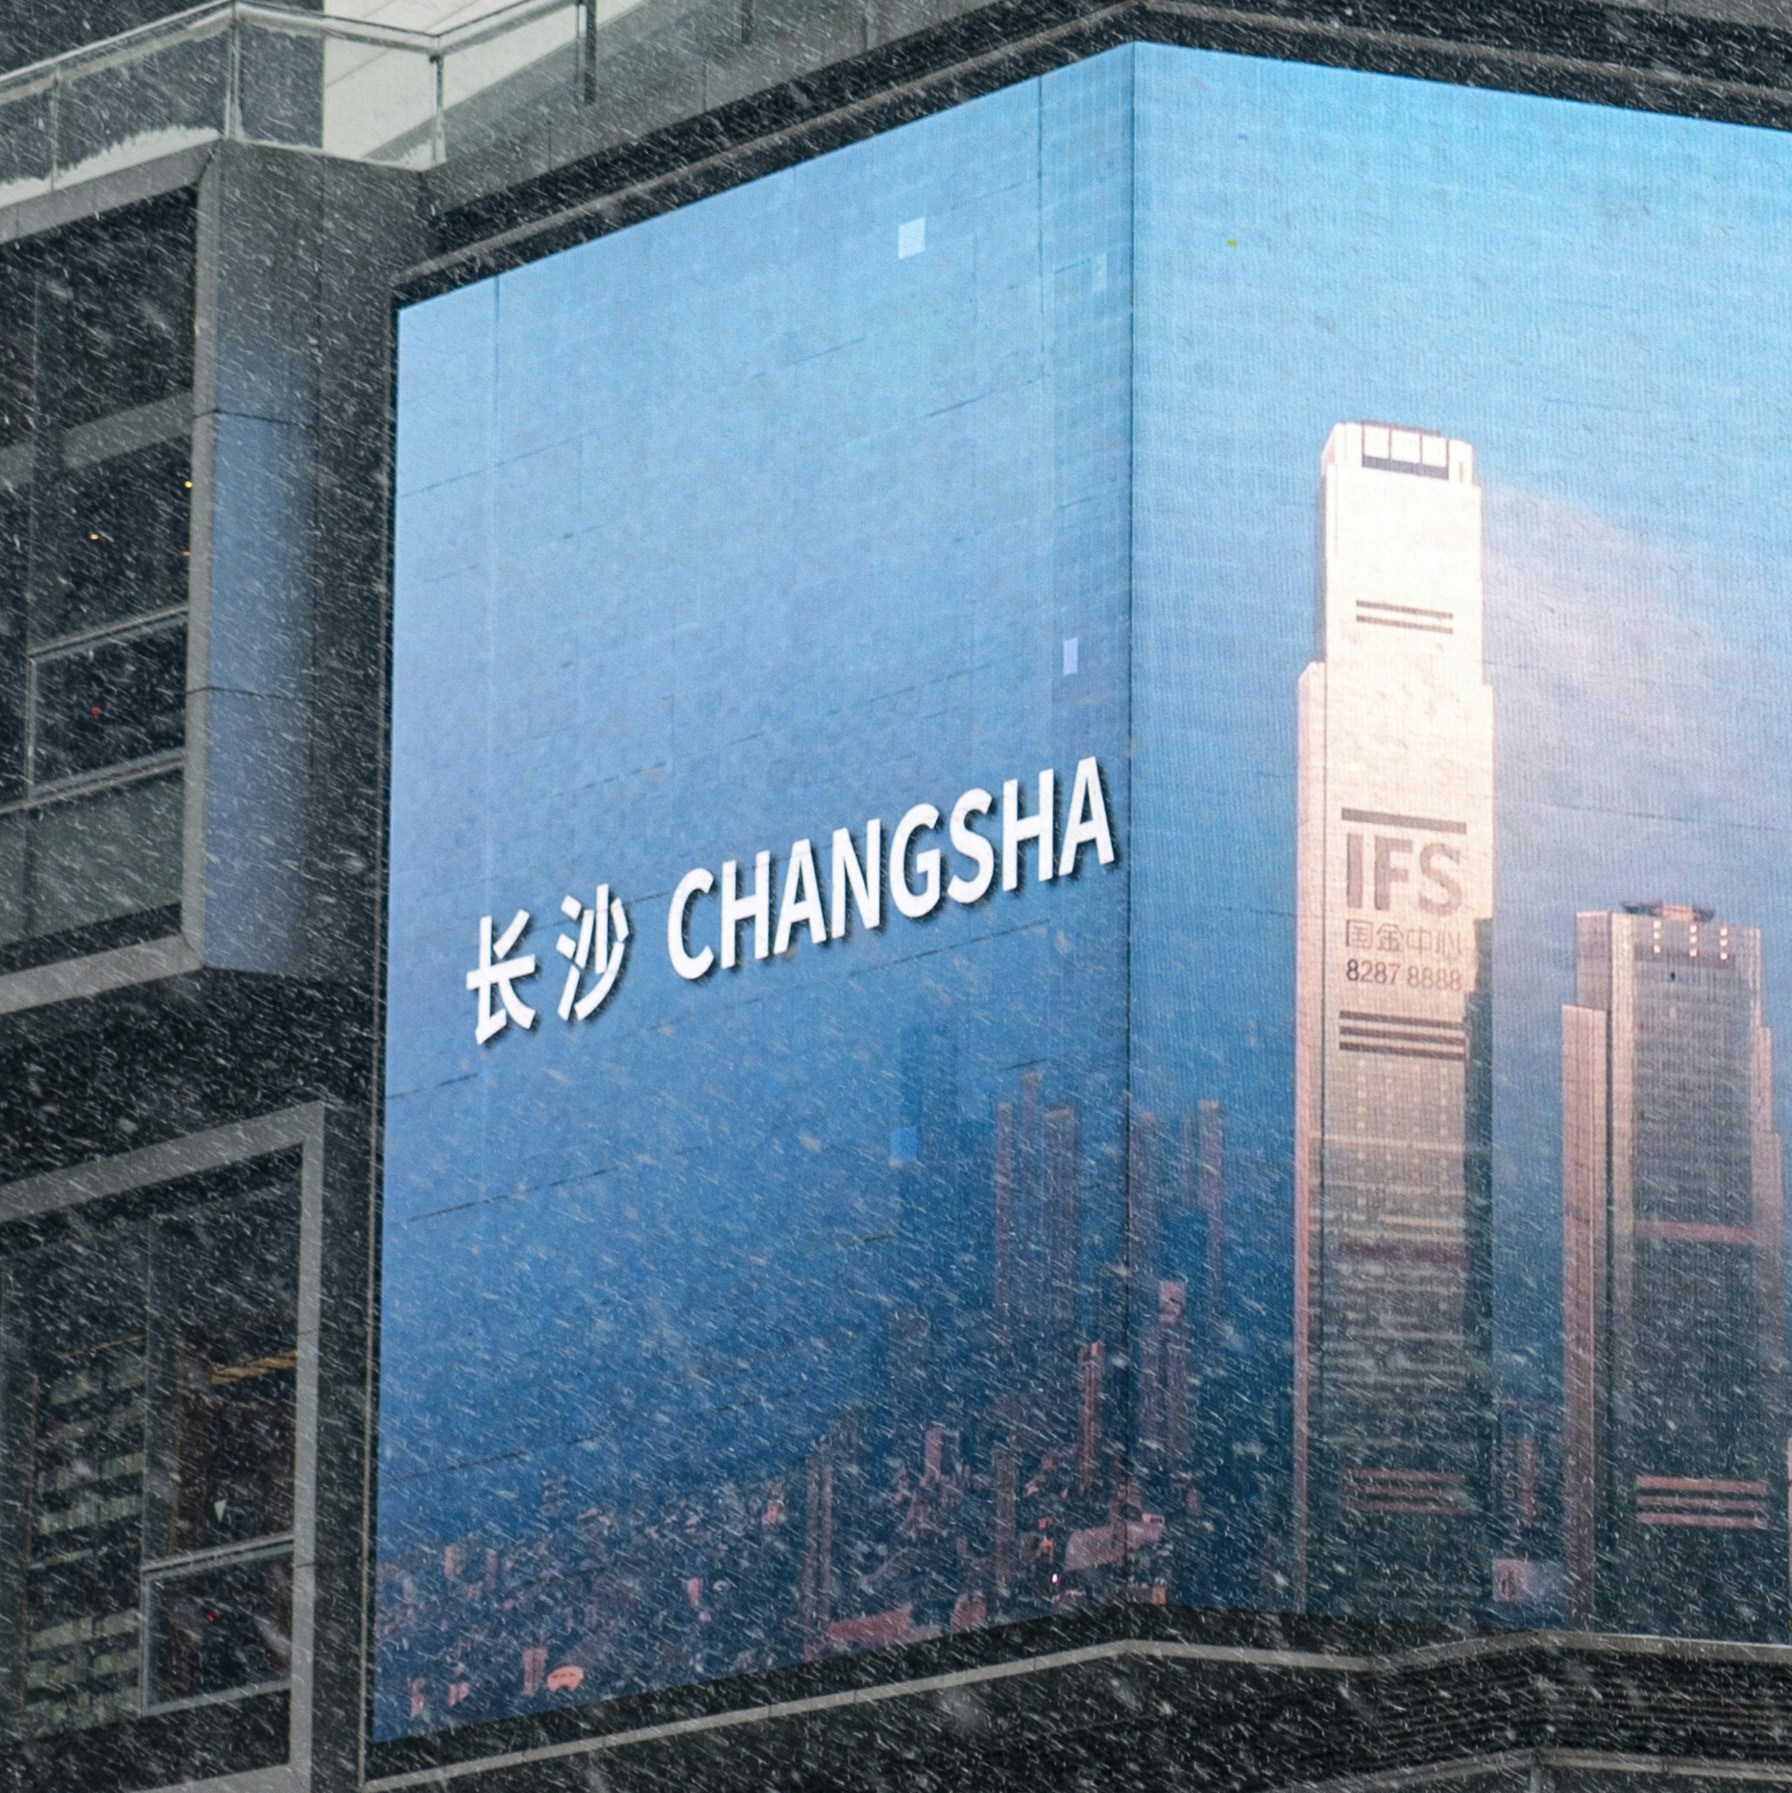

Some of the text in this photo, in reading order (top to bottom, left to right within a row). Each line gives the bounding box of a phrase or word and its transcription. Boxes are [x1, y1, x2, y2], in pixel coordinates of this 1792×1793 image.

[466, 756, 1114, 1044] 长沙 CHANGSHA
[1346, 833, 1463, 917] IFS
[1346, 919, 1462, 958] 国金中心
[1346, 959, 1463, 991] 8287 8888
